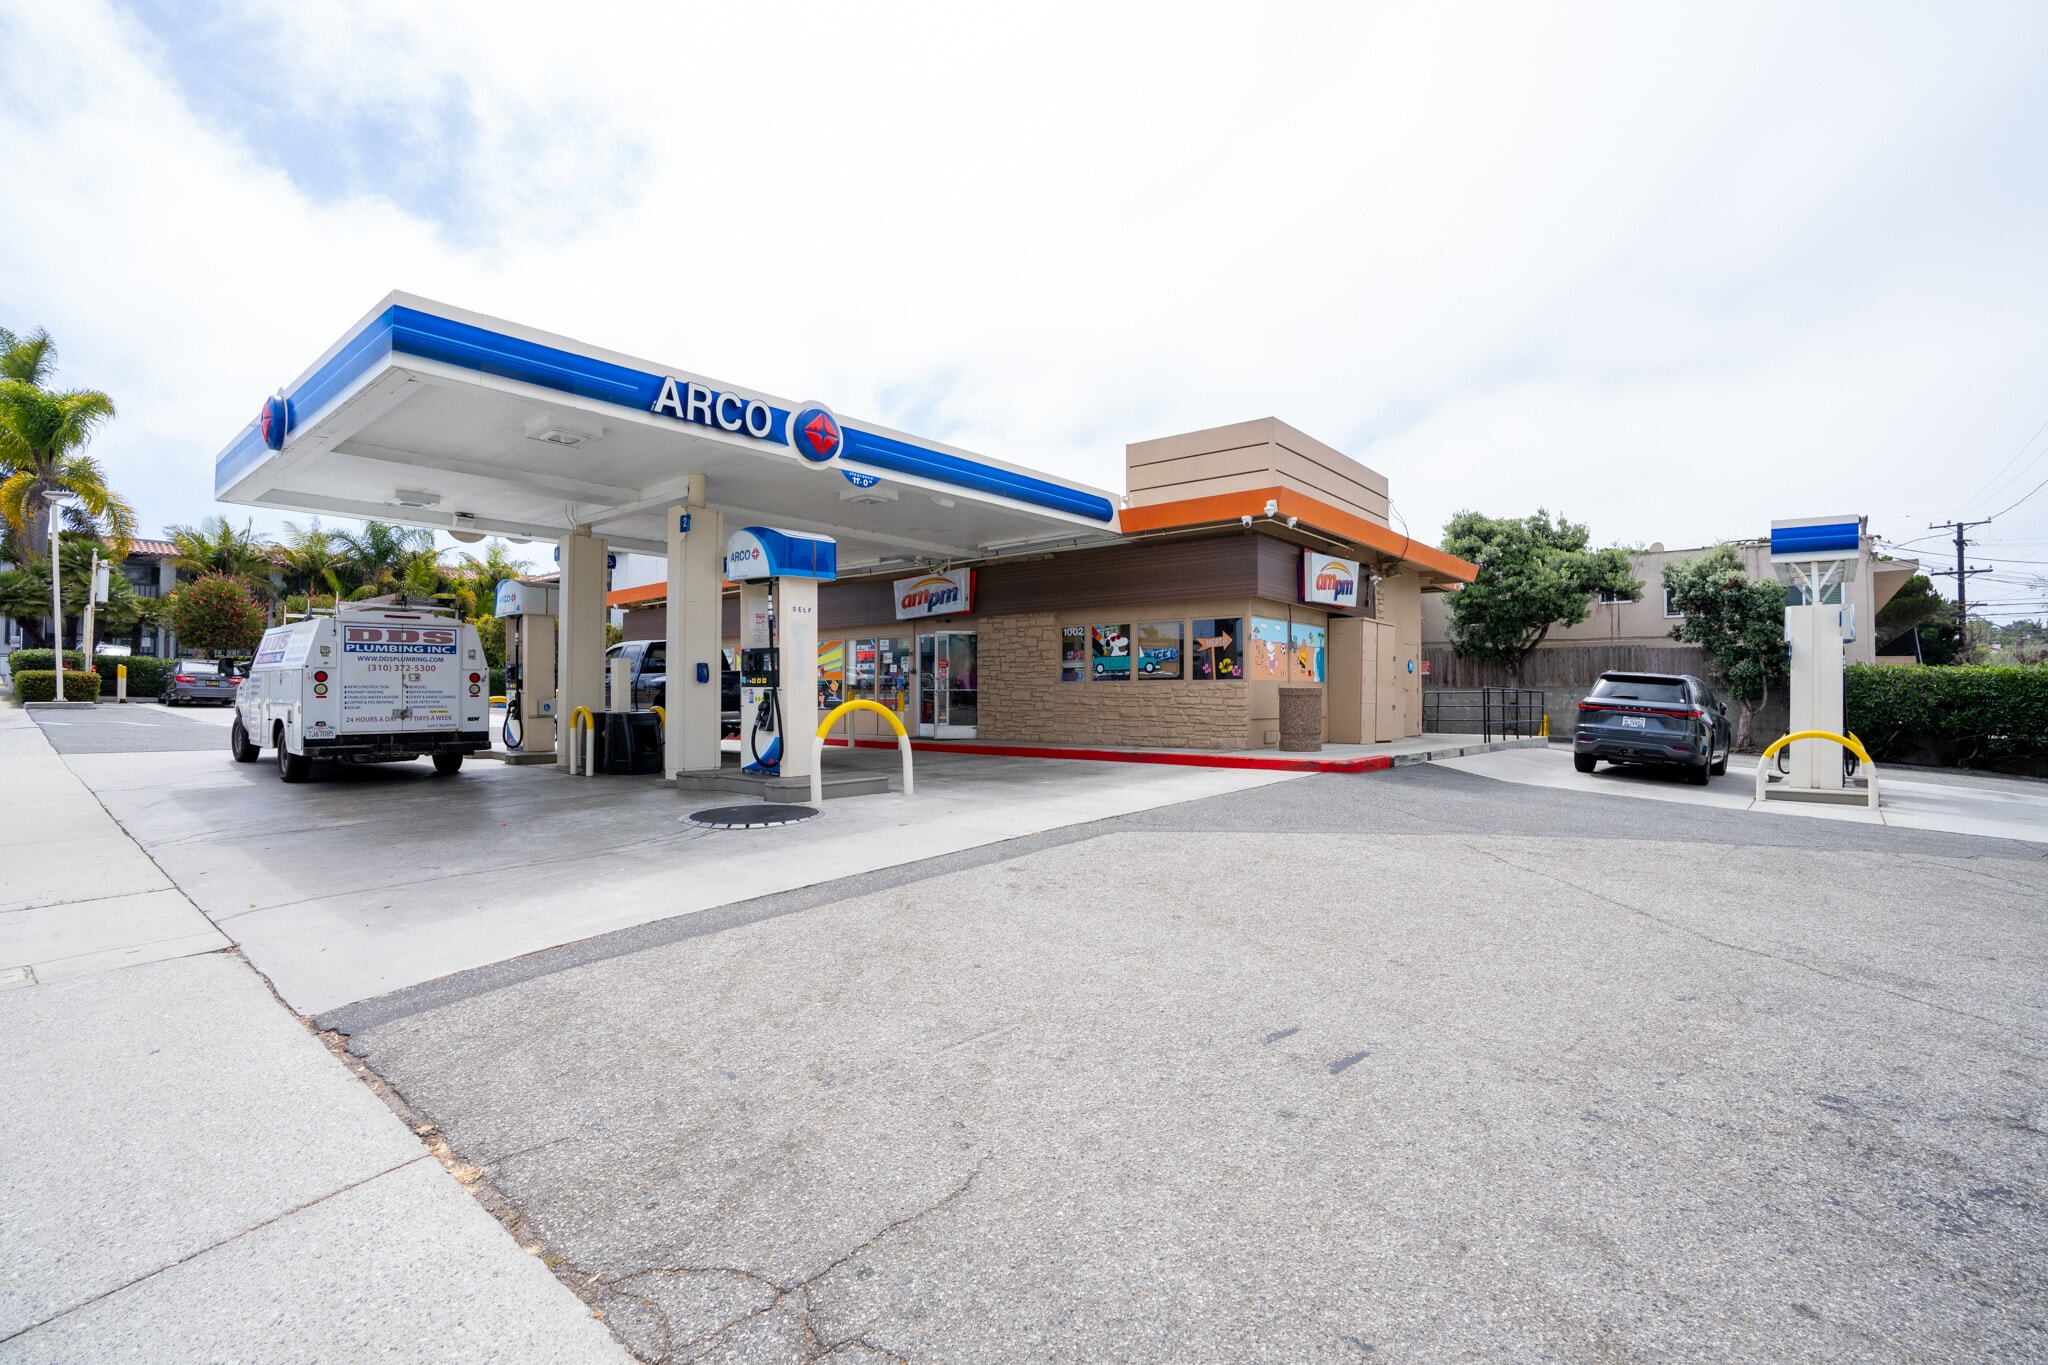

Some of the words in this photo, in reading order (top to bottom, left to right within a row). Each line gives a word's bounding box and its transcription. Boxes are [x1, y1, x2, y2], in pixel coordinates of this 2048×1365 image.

[653, 375, 773, 438] ARCO
[682, 517, 688, 528] 2
[730, 549, 751, 562] ARCO
[1315, 573, 1354, 601] ampm
[901, 586, 959, 613] ampm
[792, 606, 812, 614] SELF
[347, 628, 454, 644] DDS
[1062, 627, 1084, 637] 1002
[346, 644, 424, 653] PLUMBING
[427, 646, 456, 654] INC.
[357, 655, 445, 663] WWW.DDSPLUMBING.COM
[1153, 650, 1169, 659] ICE
[367, 664, 392, 672] (310)
[394, 664, 436, 672] 372-5300
